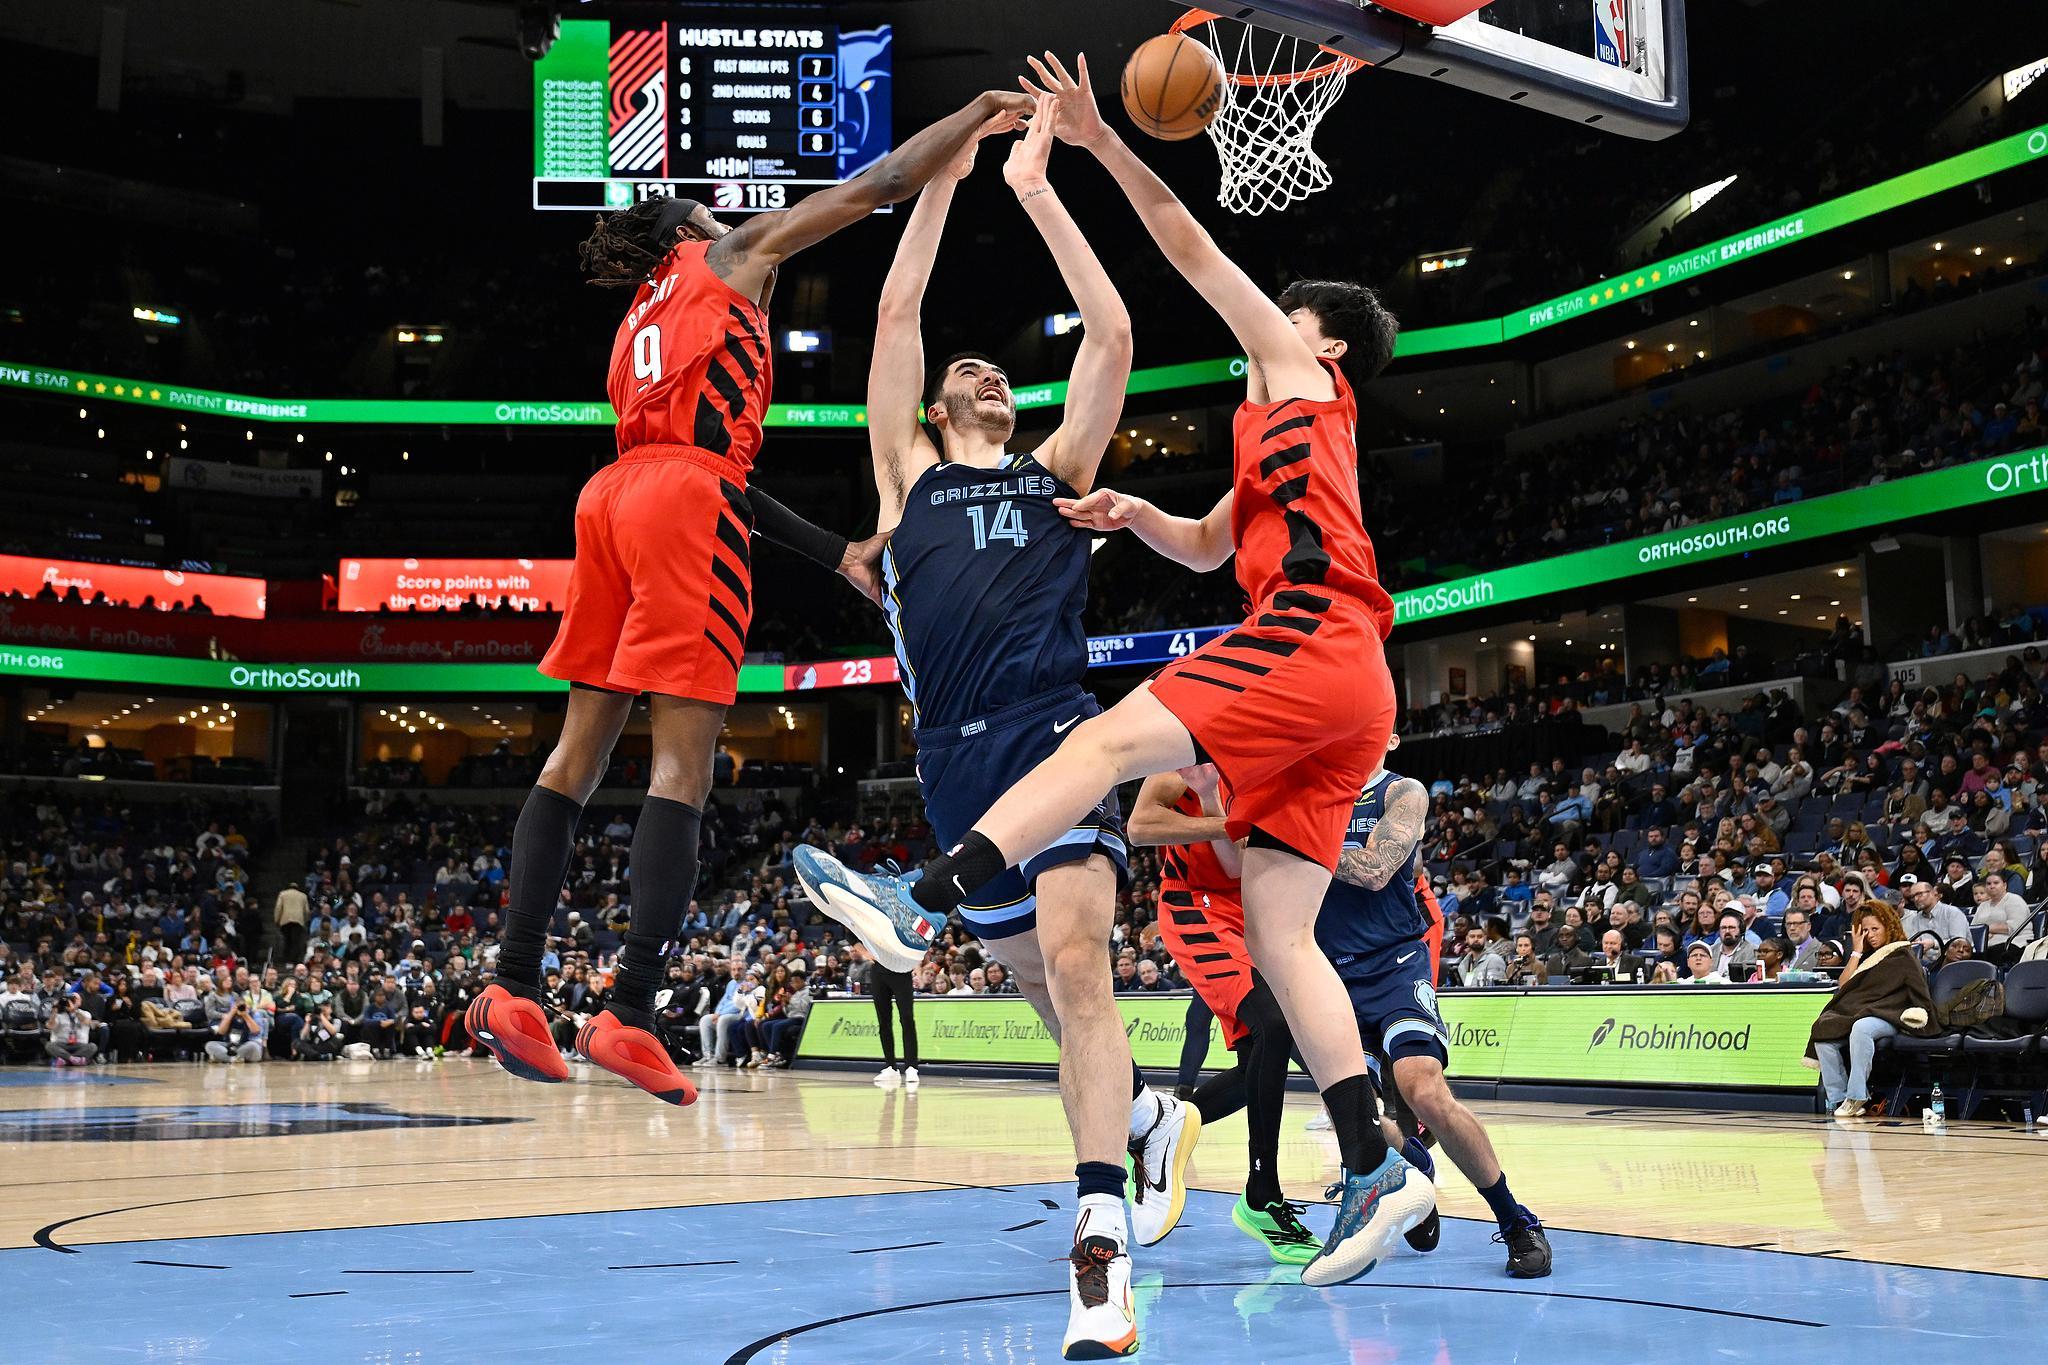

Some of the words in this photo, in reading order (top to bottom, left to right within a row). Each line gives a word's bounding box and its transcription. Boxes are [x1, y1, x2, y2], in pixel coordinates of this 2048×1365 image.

[679, 28, 757, 47] HUSTLE
[759, 29, 824, 48] STATS
[1600, 44, 1615, 63] NBA
[714, 59, 738, 73] FAST
[738, 60, 770, 74] BREAK
[770, 60, 790, 74] PTS
[812, 59, 822, 76] 7
[680, 82, 691, 100] 0
[712, 84, 733, 98] 2ND
[733, 84, 772, 99] CHANCE
[772, 85, 791, 99] PTS
[812, 84, 822, 101] 4
[680, 107, 691, 125] 3
[732, 109, 771, 124] STOCKS
[680, 132, 692, 150] 8
[737, 135, 767, 149] FOULS
[812, 134, 823, 151] 8
[706, 156, 749, 178] HHM
[746, 184, 786, 208] 113
[1529, 307, 1554, 326] FIVE
[1556, 297, 1583, 317] STAR
[1668, 249, 1718, 278] PATIENT
[1721, 219, 1804, 260] EXPERIENCE
[633, 324, 662, 384] 9
[0, 366, 30, 383] FIVE
[35, 372, 69, 388] STAR
[169, 391, 222, 409] PATIENT
[225, 399, 307, 417] EXPERIENCE
[495, 404, 602, 421] OrthoSouth
[786, 410, 815, 422] FIVE
[819, 410, 848, 422] STAR
[930, 475, 1057, 506] GRIZZLIES
[966, 500, 1029, 550] 14
[1638, 516, 1791, 563] ORTHOSOUTH.ORG
[396, 574, 442, 589] Score
[445, 575, 494, 591] points
[496, 575, 530, 589] with
[390, 594, 416, 608] the
[508, 594, 540, 611] App
[1395, 578, 1494, 620] rthoSouth
[1125, 638, 1135, 649] 6
[1168, 632, 1196, 657] 41
[1106, 651, 1112, 662] 1
[230, 666, 361, 689] OrthoSouth
[842, 660, 872, 684] 23
[1894, 668, 1916, 684] 105
[932, 1020, 959, 1038] Your
[958, 1020, 1000, 1045] Money.
[1003, 1020, 1032, 1040] Your
[1445, 1022, 1500, 1047] Move.
[1618, 1023, 1752, 1052] Robinhood
